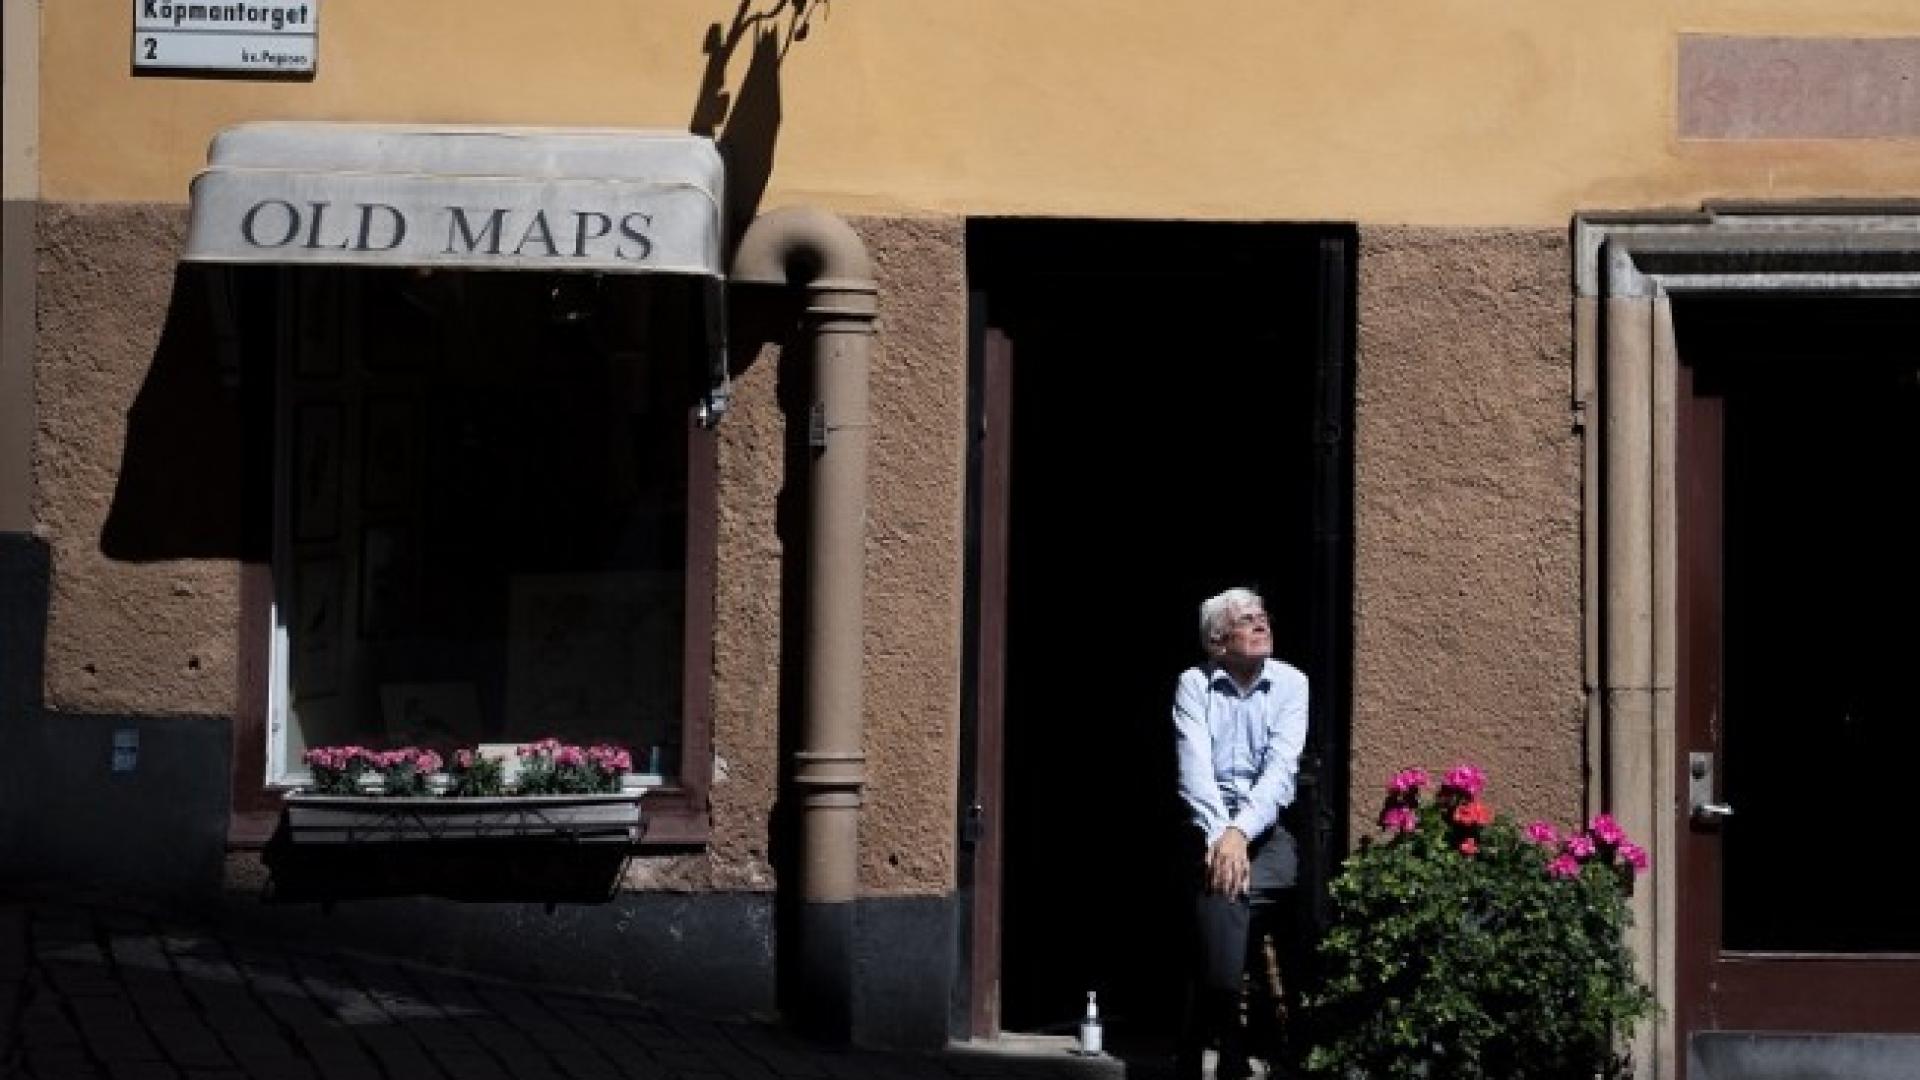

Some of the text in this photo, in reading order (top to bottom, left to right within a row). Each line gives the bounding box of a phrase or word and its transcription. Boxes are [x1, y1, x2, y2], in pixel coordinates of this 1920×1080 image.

[144, 38, 157, 59] 2
[241, 200, 654, 260] OLD MAPS
